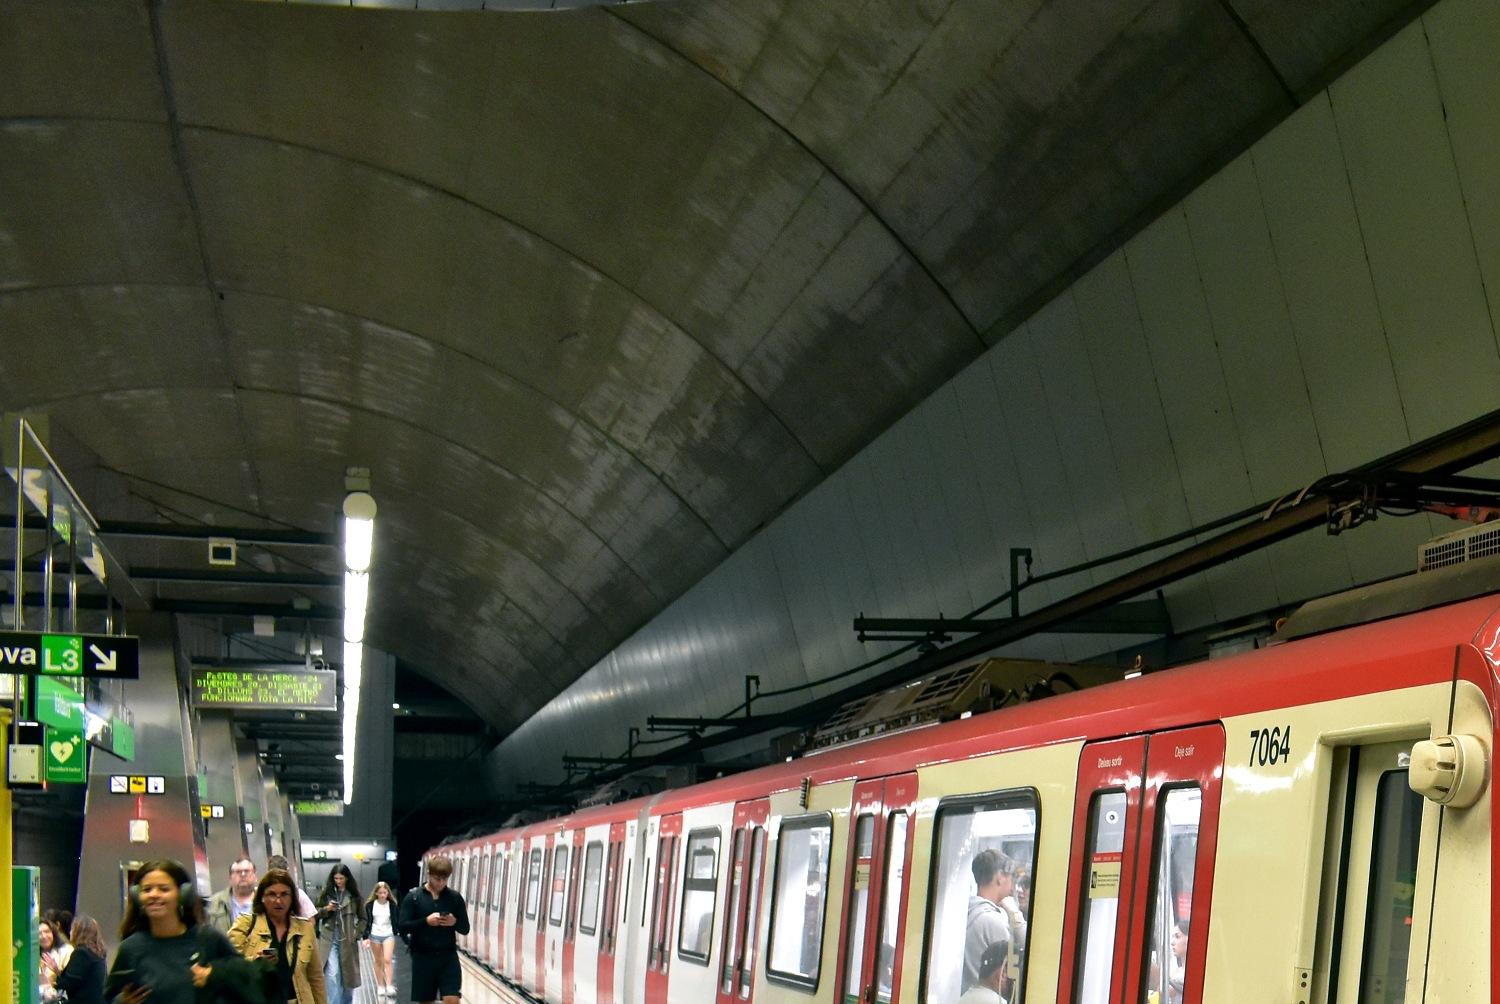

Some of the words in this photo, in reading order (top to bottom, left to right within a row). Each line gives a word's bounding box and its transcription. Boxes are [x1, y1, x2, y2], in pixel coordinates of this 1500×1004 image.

[0, 646, 37, 665] va
[44, 647, 79, 672] L3
[1249, 725, 1291, 767] 7064
